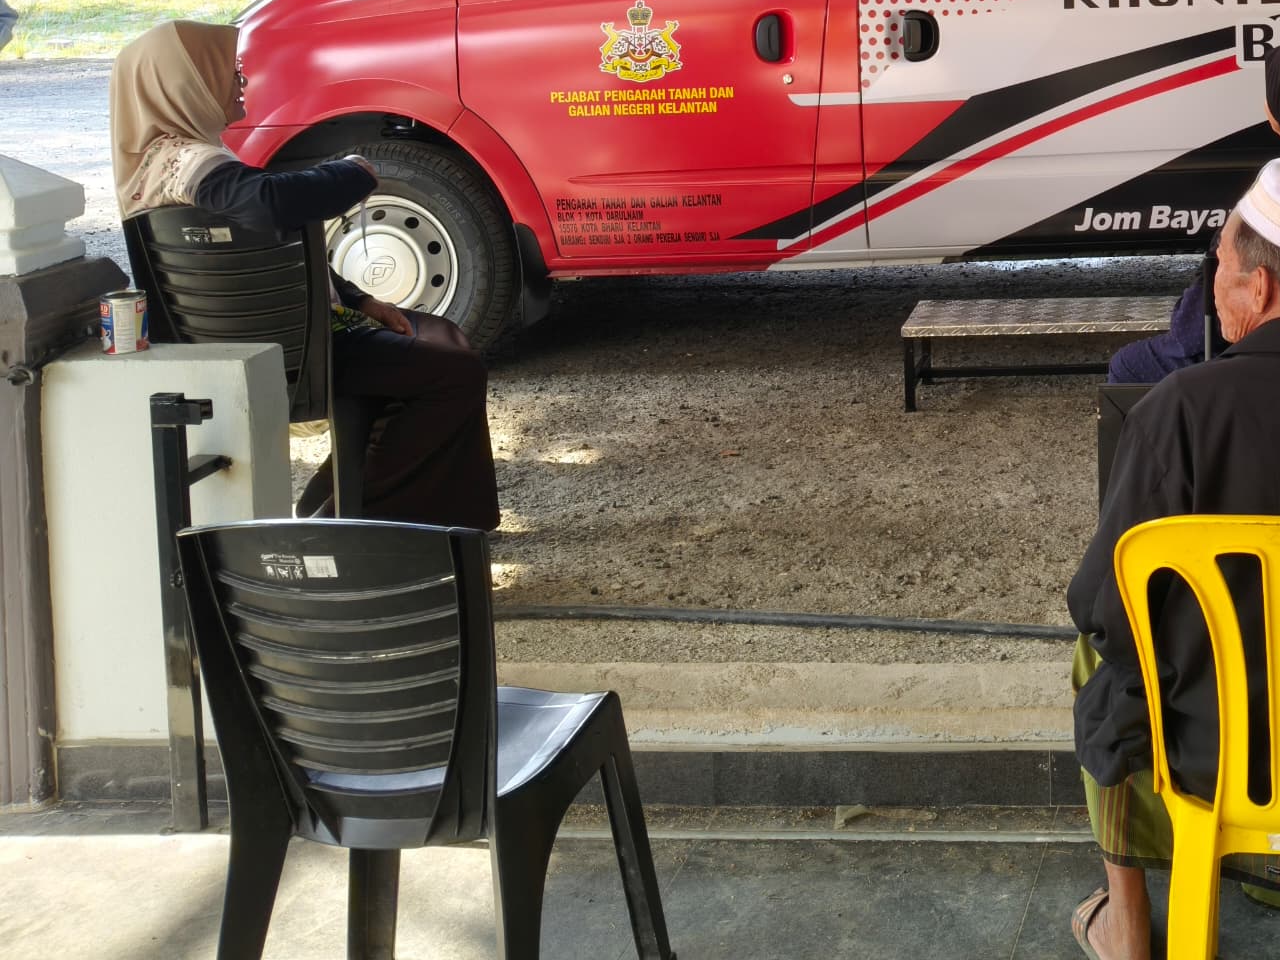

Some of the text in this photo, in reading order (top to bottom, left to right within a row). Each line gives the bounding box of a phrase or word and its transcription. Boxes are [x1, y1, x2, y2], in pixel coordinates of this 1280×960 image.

[550, 87, 734, 103] PEJABAT PENGARAH TANAH DAN
[568, 101, 717, 117] GALIAN NEGERI KELANTAN
[556, 194, 722, 210] PENGARAH TANAH DAN GALIAN KELANTAN
[1074, 205, 1232, 235] Jom Baya
